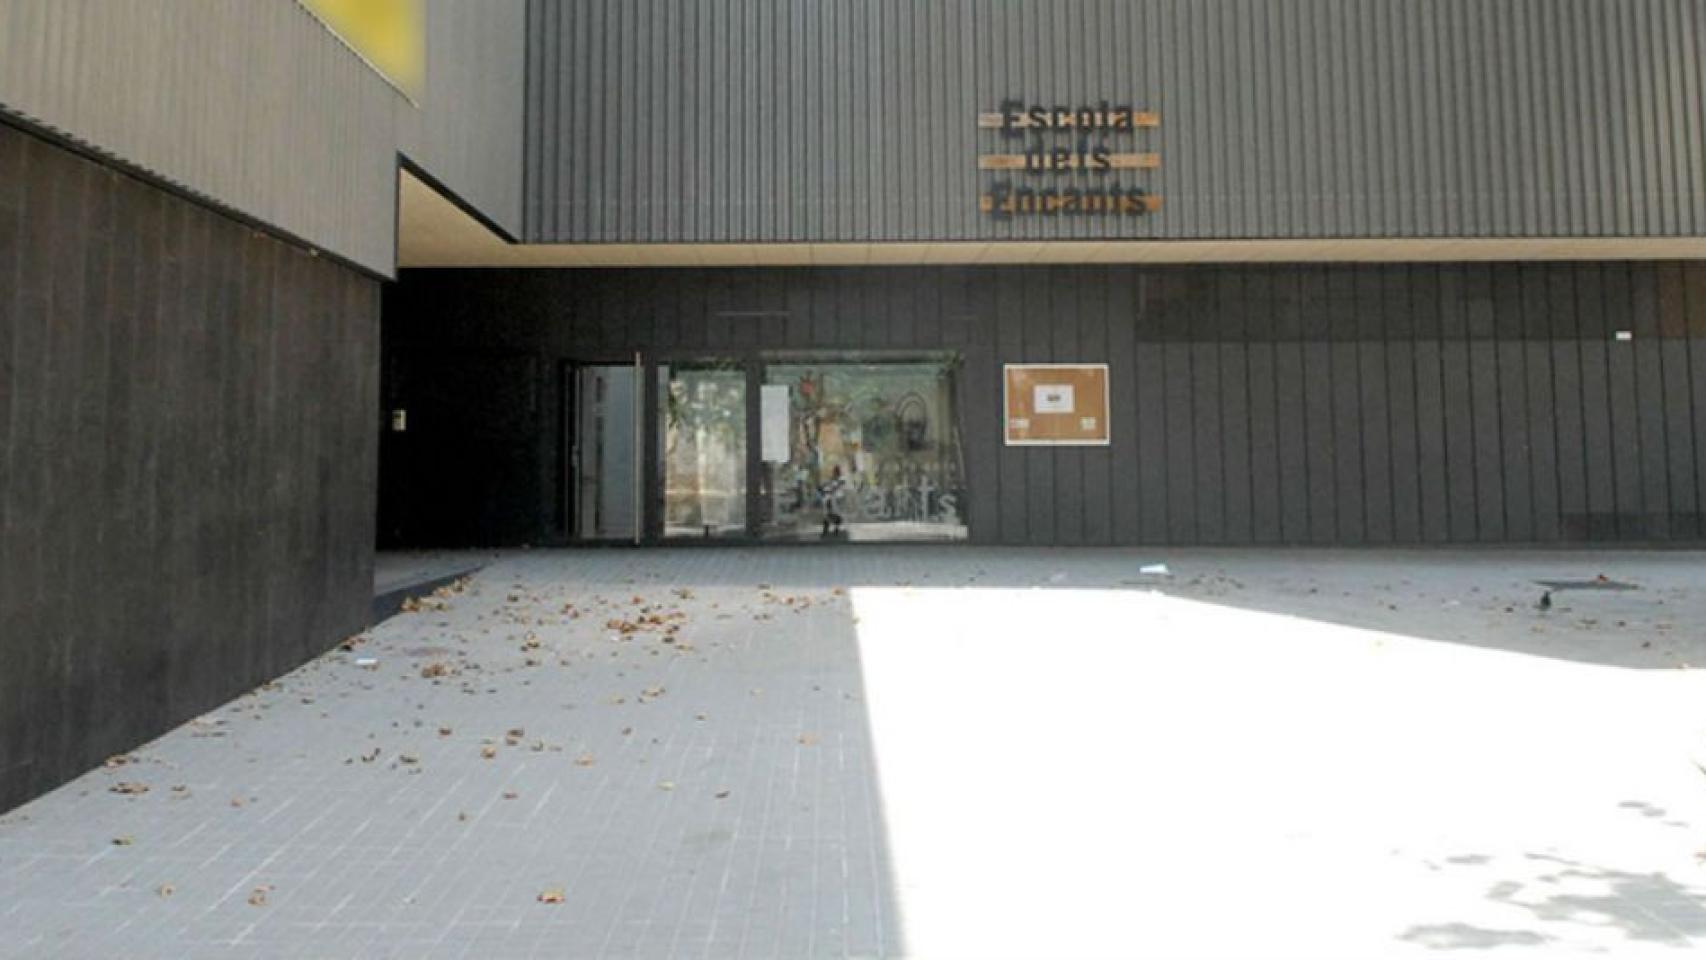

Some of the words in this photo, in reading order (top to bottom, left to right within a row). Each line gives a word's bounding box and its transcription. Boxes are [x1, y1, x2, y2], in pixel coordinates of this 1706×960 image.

[1001, 100, 1134, 136] Escola
[1026, 138, 1111, 175] dels
[991, 181, 1147, 219] Encants
